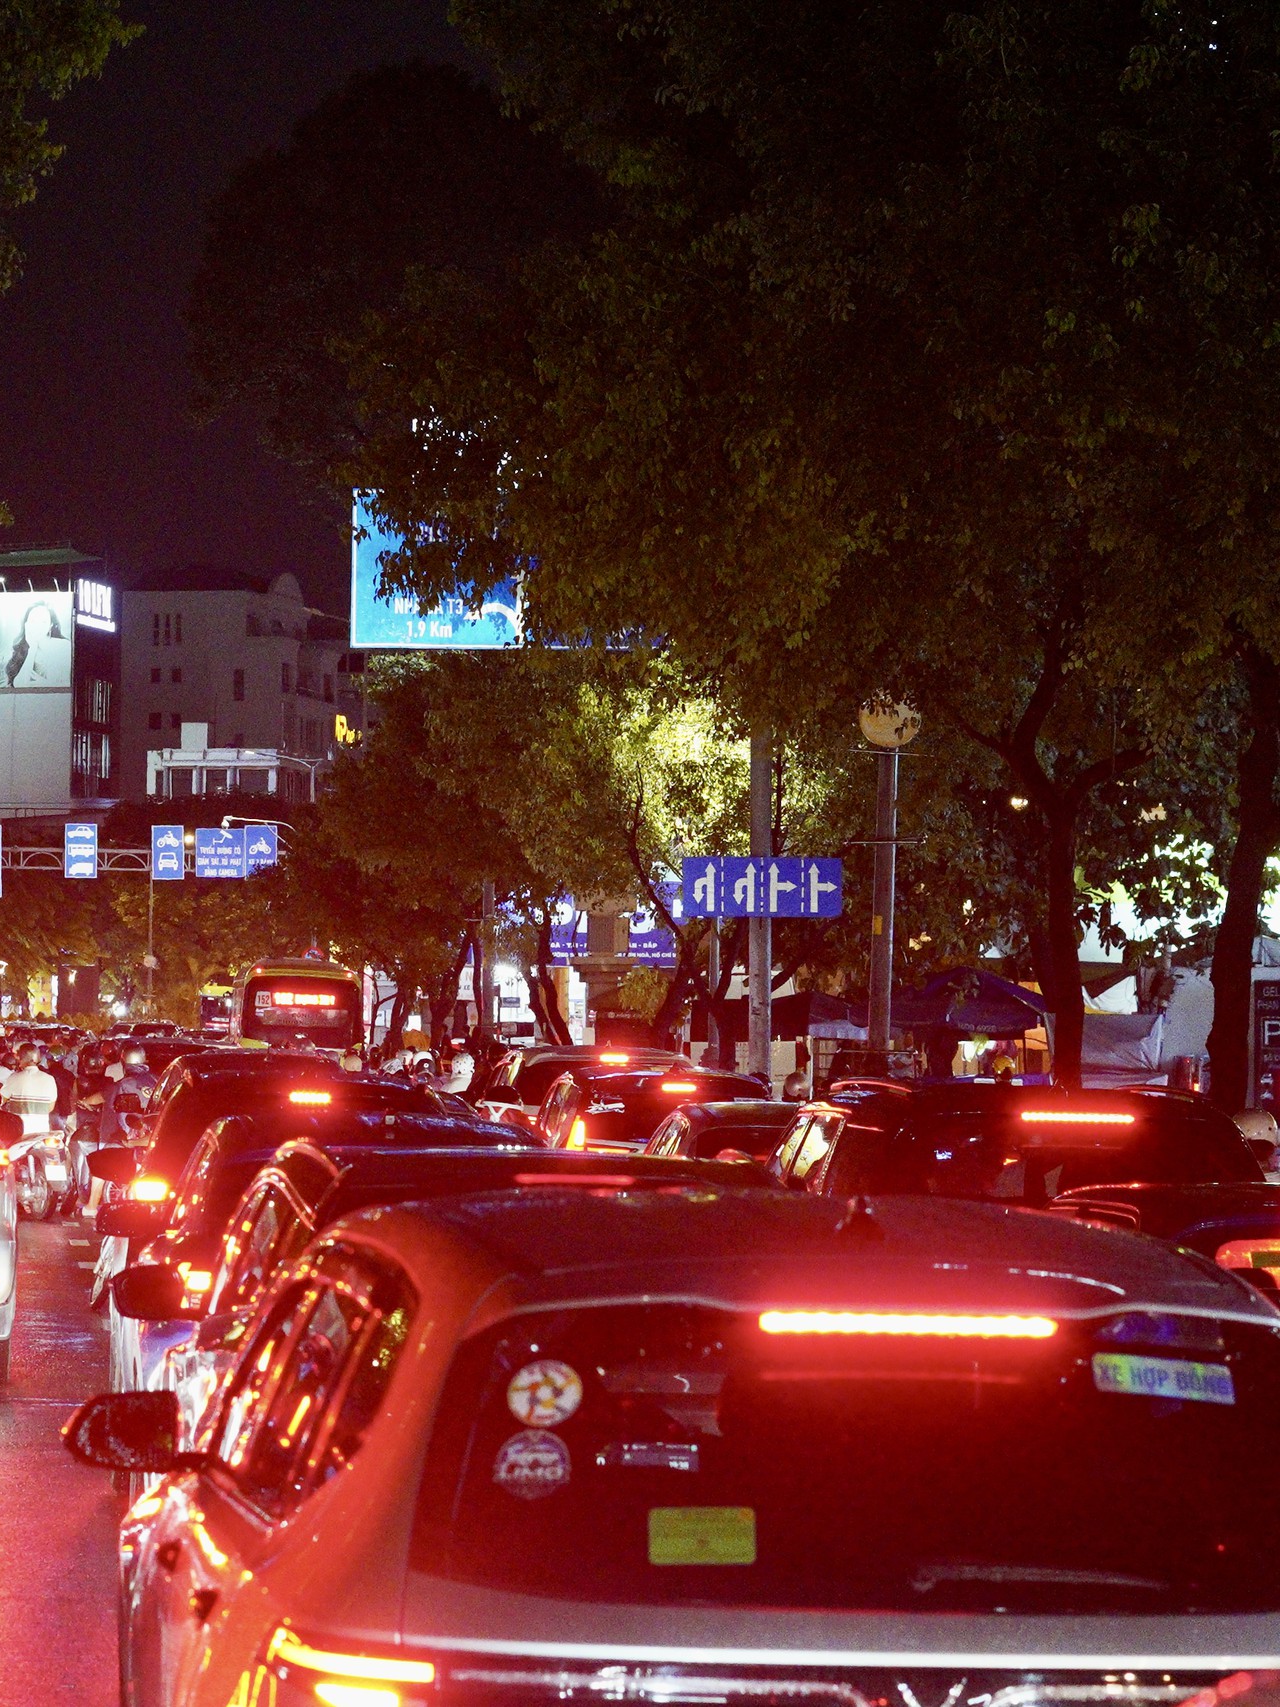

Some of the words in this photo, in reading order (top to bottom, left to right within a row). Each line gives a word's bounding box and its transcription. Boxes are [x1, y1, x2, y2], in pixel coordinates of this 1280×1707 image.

[447, 598, 463, 615] T3
[430, 620, 452, 637] Km
[257, 995, 270, 1005] 152
[1099, 1362, 1124, 1386] XE
